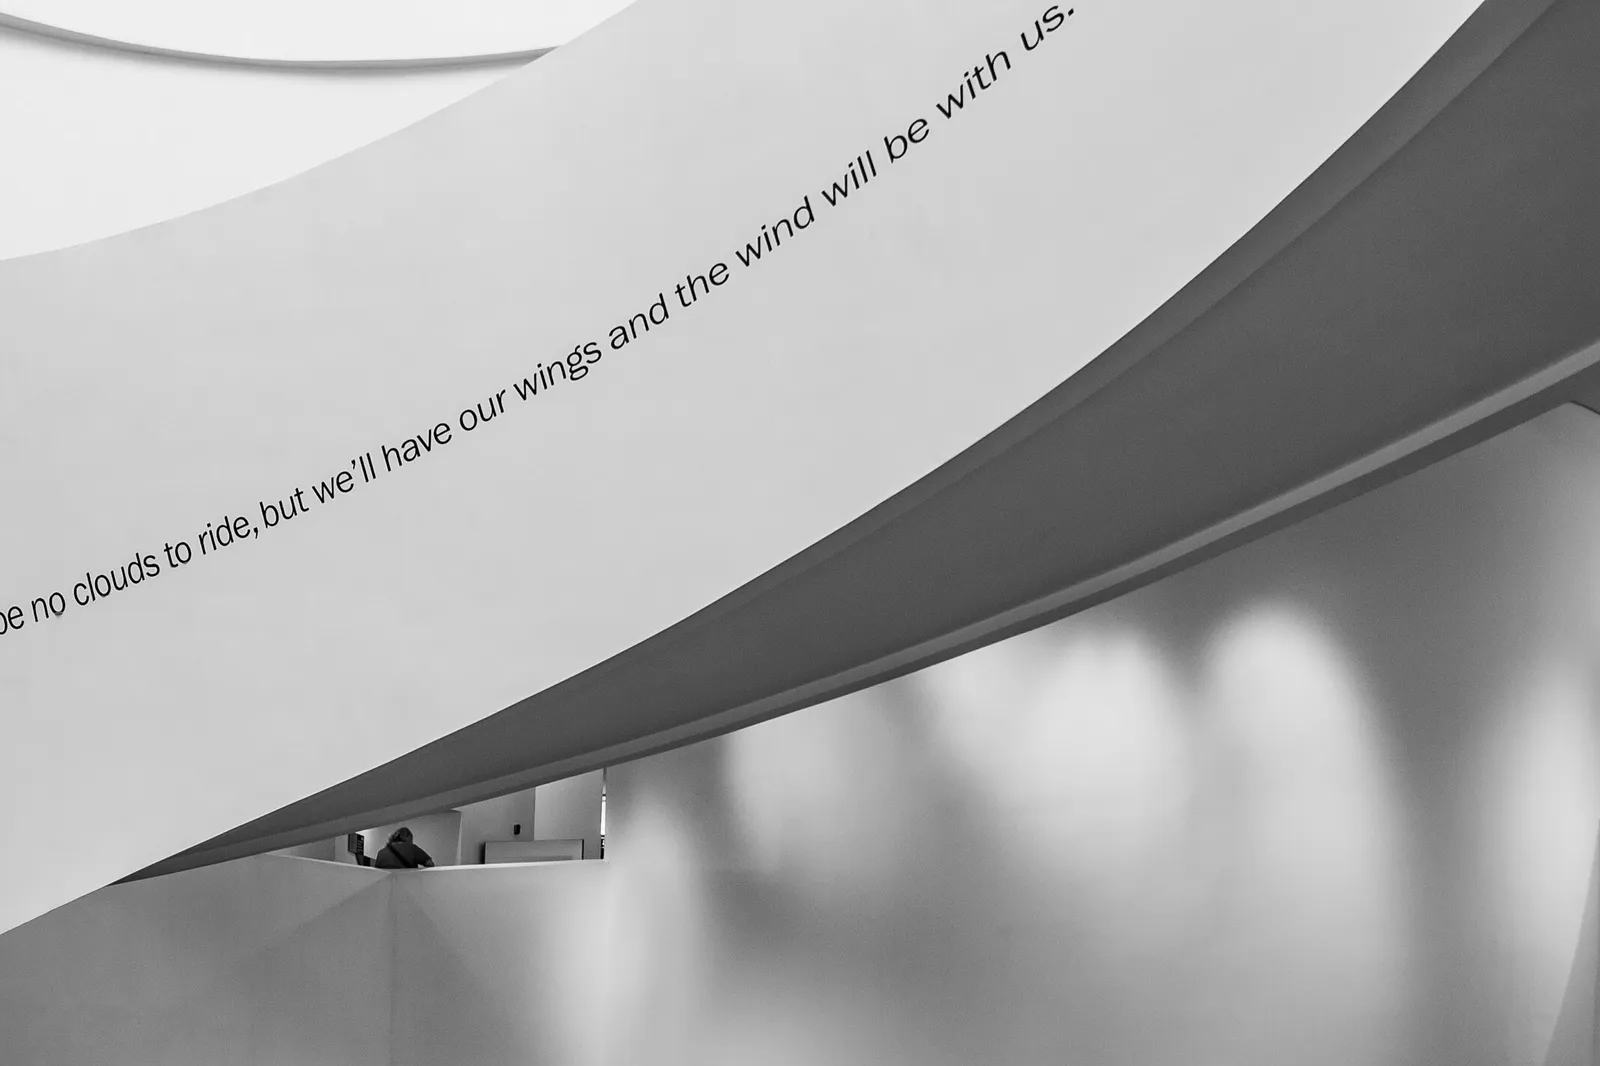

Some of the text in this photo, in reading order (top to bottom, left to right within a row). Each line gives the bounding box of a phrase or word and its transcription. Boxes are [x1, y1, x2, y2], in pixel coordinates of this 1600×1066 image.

[31, 591, 66, 623] no
[73, 552, 161, 606] clouds
[163, 541, 192, 568] to
[381, 422, 453, 472] have
[459, 389, 506, 432] our
[512, 341, 602, 401] wings
[608, 292, 670, 350] and
[674, 262, 730, 308] the
[735, 195, 815, 268] wind
[821, 150, 877, 207] will
[883, 118, 930, 164] be
[935, 51, 1011, 120] with
[1020, 5, 1075, 51] us.
